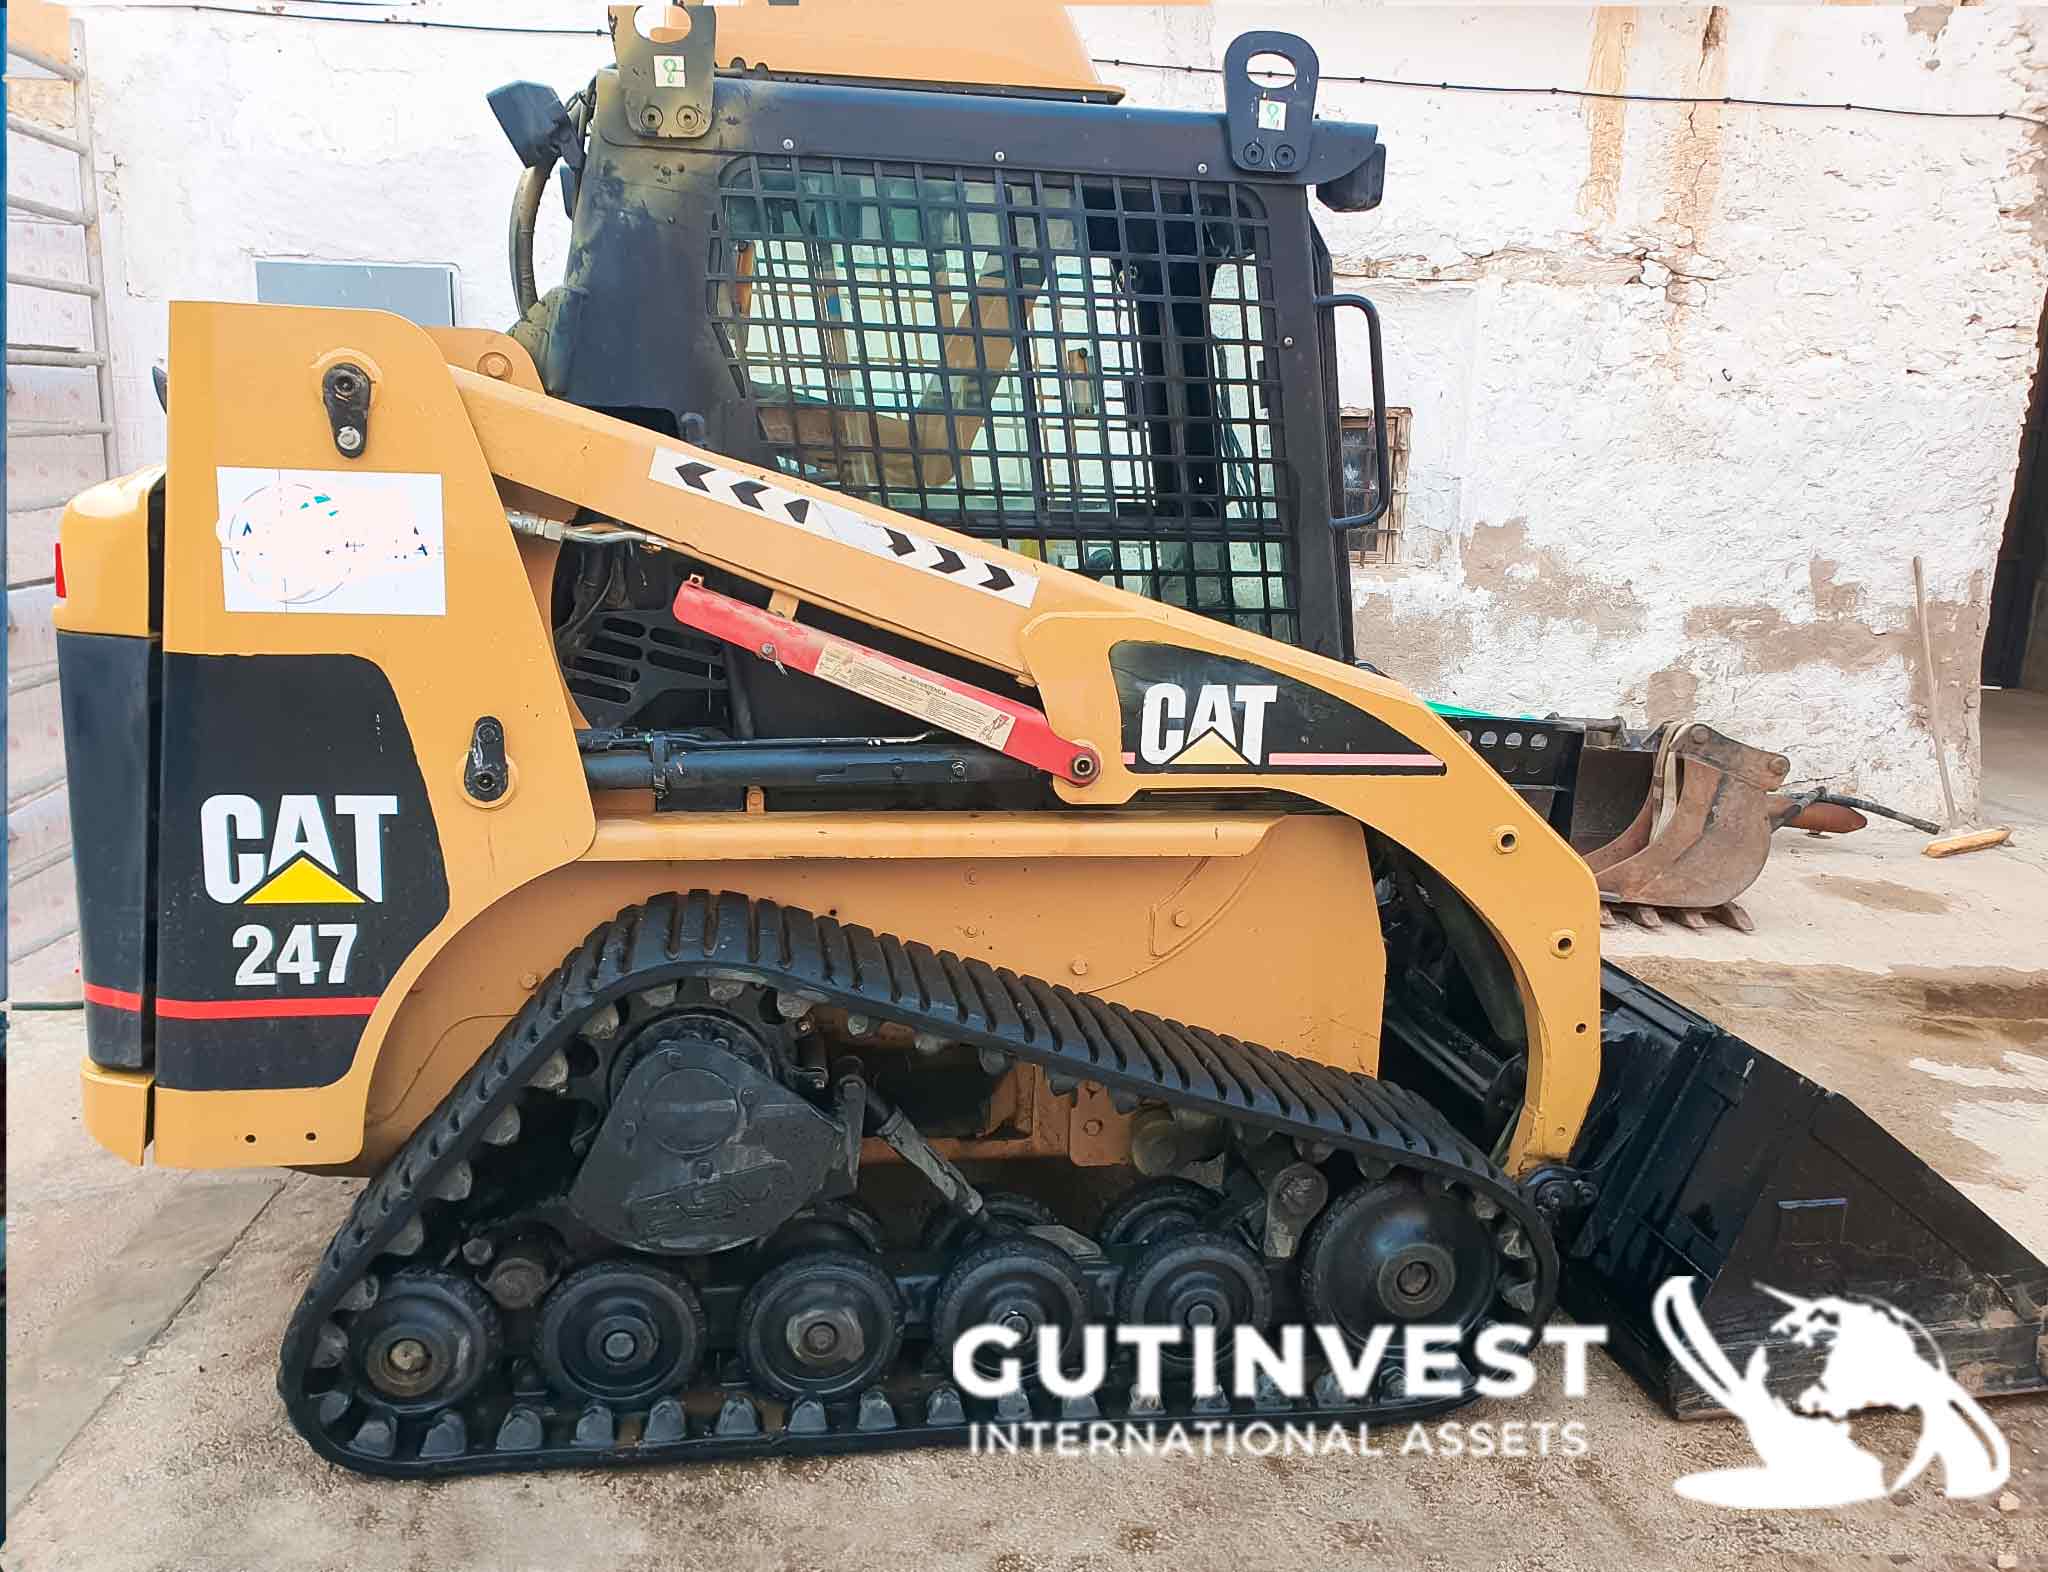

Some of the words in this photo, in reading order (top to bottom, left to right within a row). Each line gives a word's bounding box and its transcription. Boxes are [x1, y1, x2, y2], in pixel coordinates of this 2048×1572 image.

[1141, 682, 1278, 765] CAT
[201, 794, 398, 904] CAT
[232, 924, 357, 986] 247
